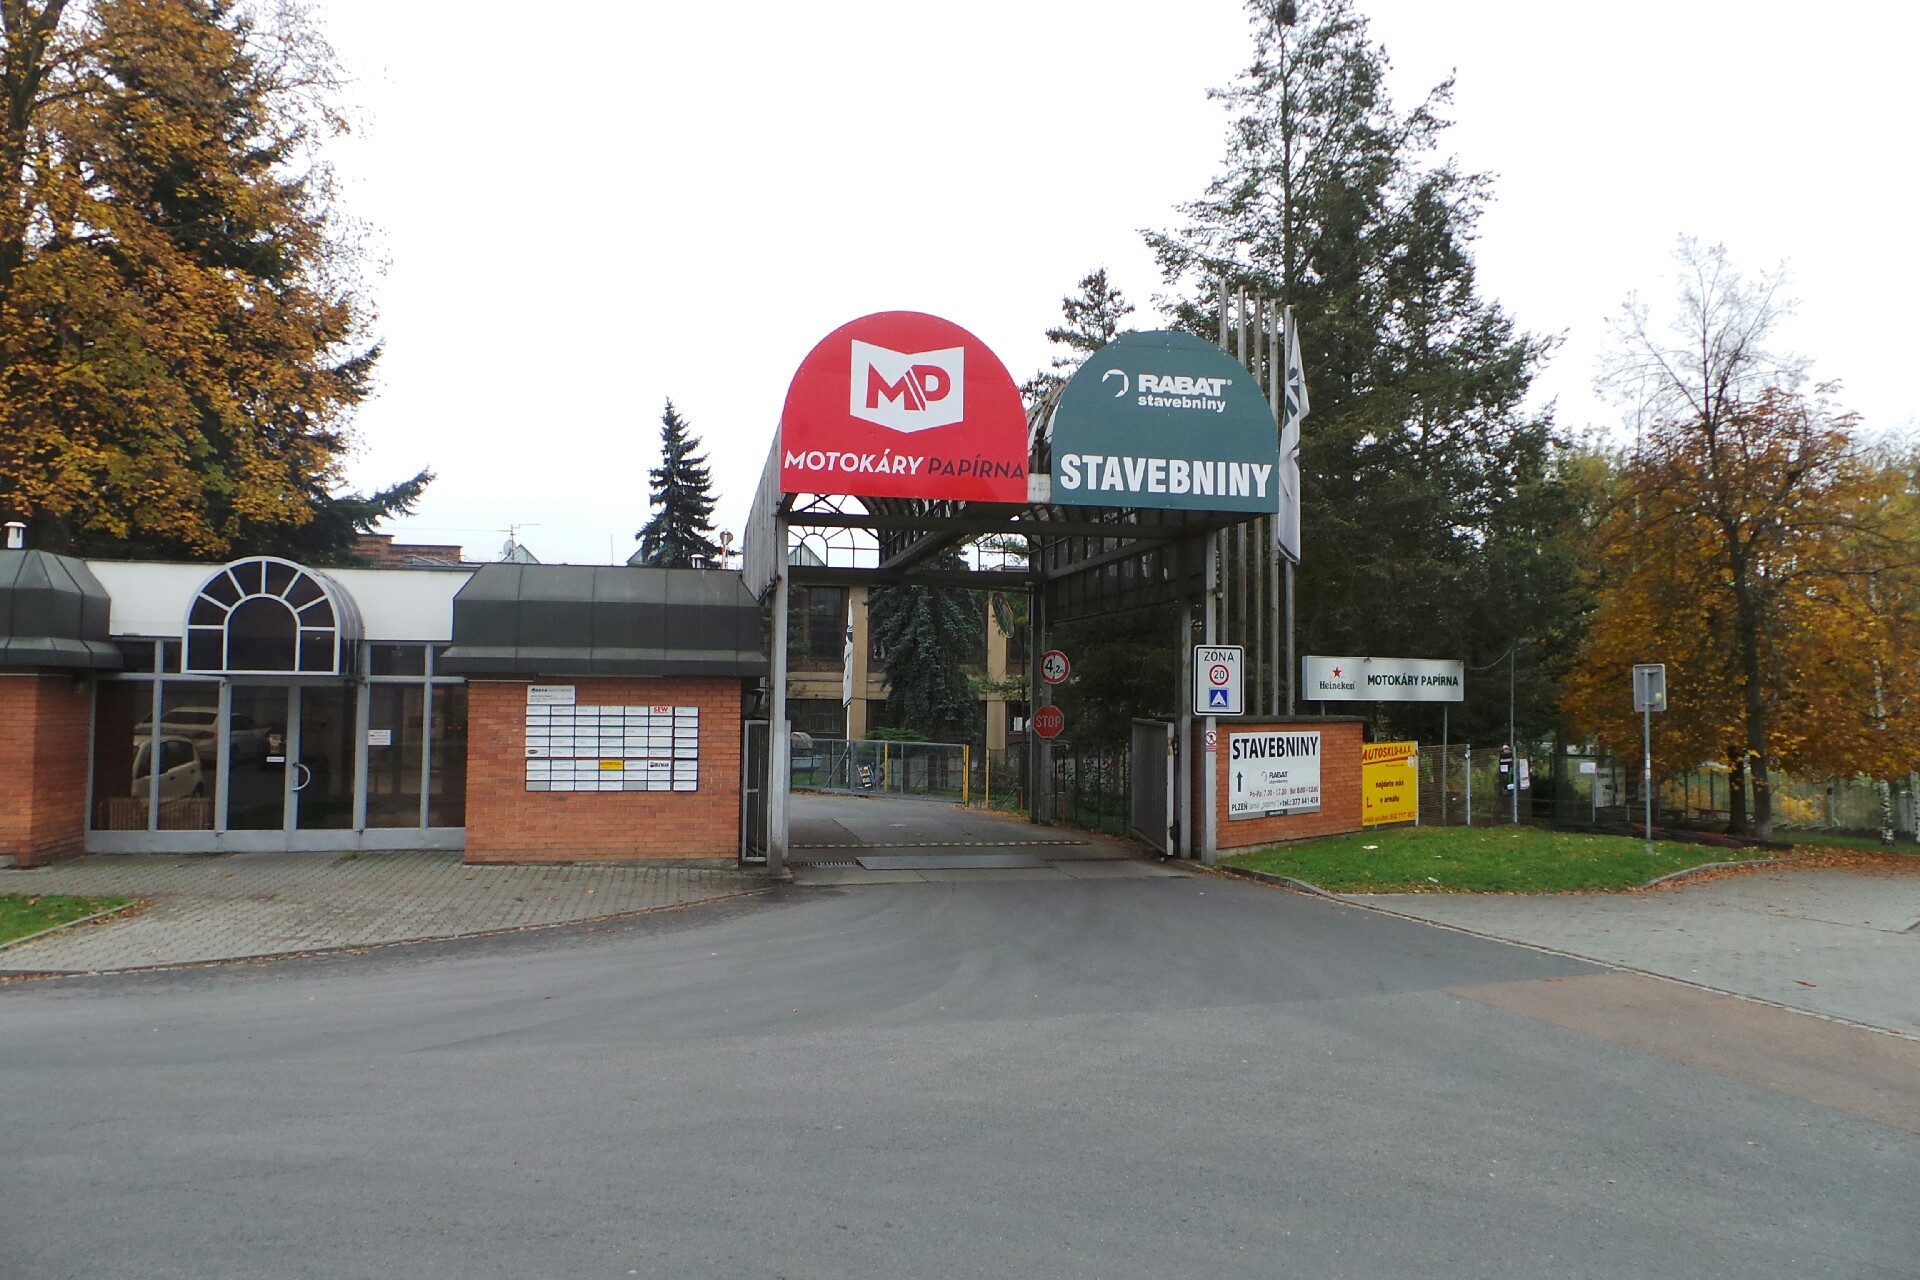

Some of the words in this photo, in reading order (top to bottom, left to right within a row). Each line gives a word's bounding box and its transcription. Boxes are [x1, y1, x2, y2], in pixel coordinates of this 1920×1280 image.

[1138, 394, 1226, 412] stavebniny
[784, 448, 924, 475] MOTOKÁRY
[927, 453, 1024, 479] PAPÍRNA
[1060, 453, 1272, 498] STAVEBNINY
[1203, 649, 1235, 662] ZÓNA
[1213, 670, 1225, 679] 20
[1367, 672, 1419, 686] MOTOKÁRY
[1421, 673, 1459, 687] PAPÍRNA
[1319, 681, 1355, 690] Heineken
[1035, 715, 1062, 728] STOP
[1232, 736, 1319, 760] STAVEBNINY
[1269, 771, 1288, 779] RABAT
[1375, 780, 1394, 790] najdete
[1231, 801, 1248, 811] PLZEŇ
[1292, 798, 1301, 806] 377
[1384, 795, 1400, 803] areálu
